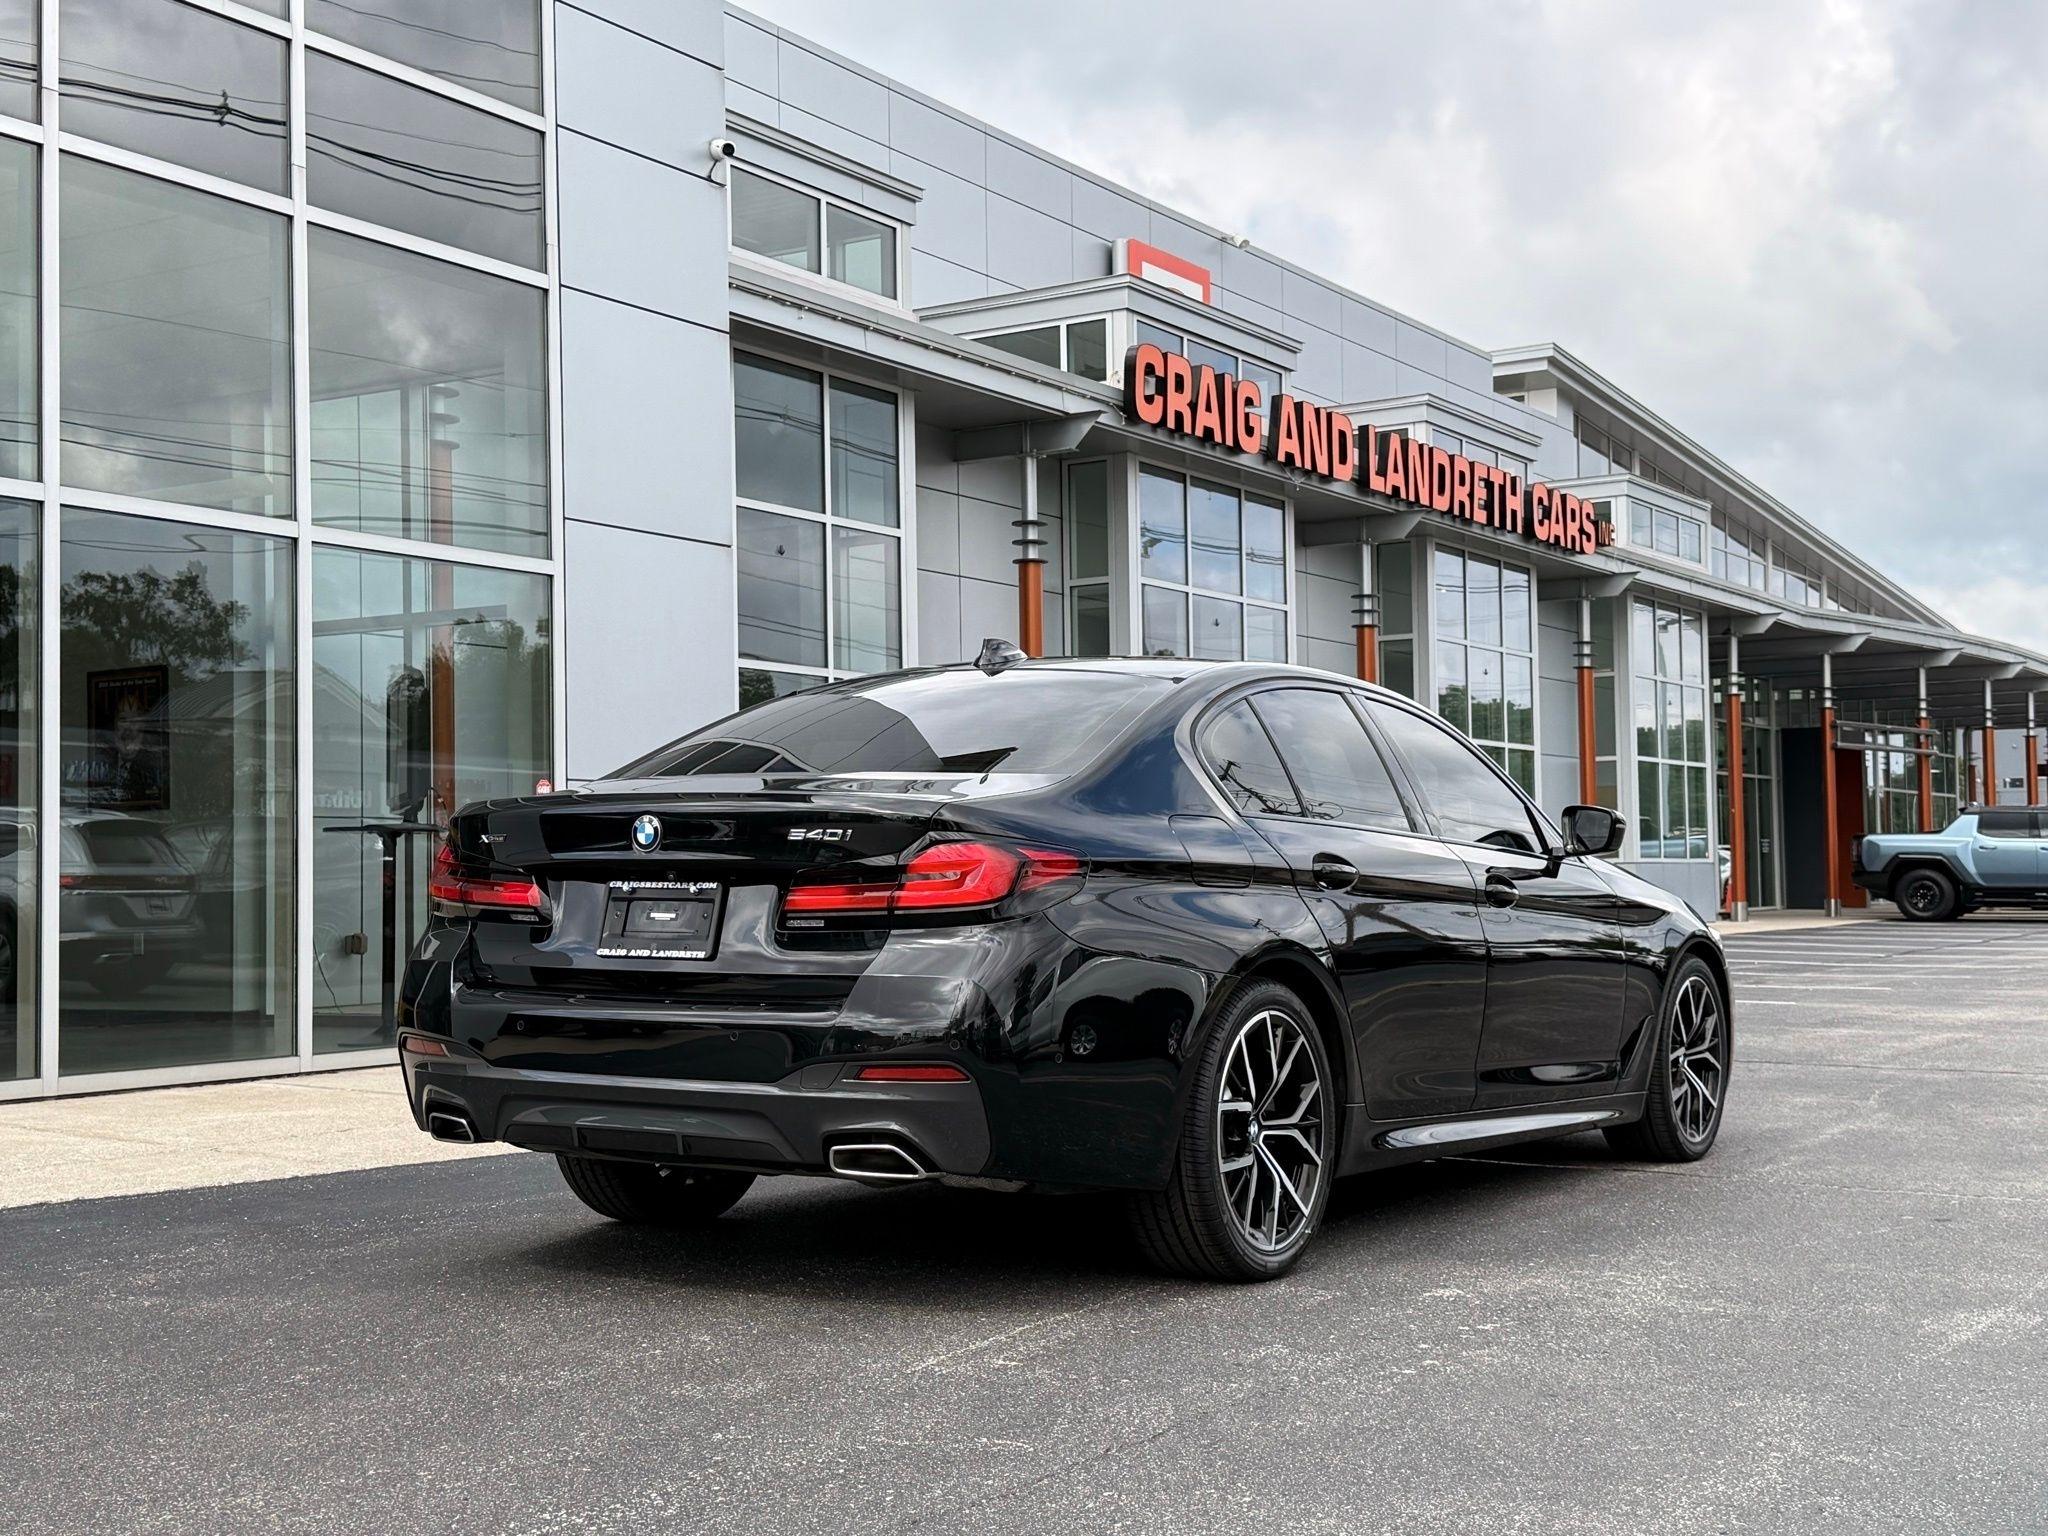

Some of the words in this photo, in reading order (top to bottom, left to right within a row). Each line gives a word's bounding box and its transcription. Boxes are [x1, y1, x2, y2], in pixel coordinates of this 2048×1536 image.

[1133, 342, 1262, 455] CRAIG
[1276, 393, 1355, 483] AND
[1368, 423, 1524, 535] LANDRETH
[1531, 482, 1597, 555] CARS
[787, 828, 853, 841] 540i
[596, 948, 627, 957] CRAIG
[628, 949, 651, 957] AND
[651, 949, 706, 959] LANDRETH
